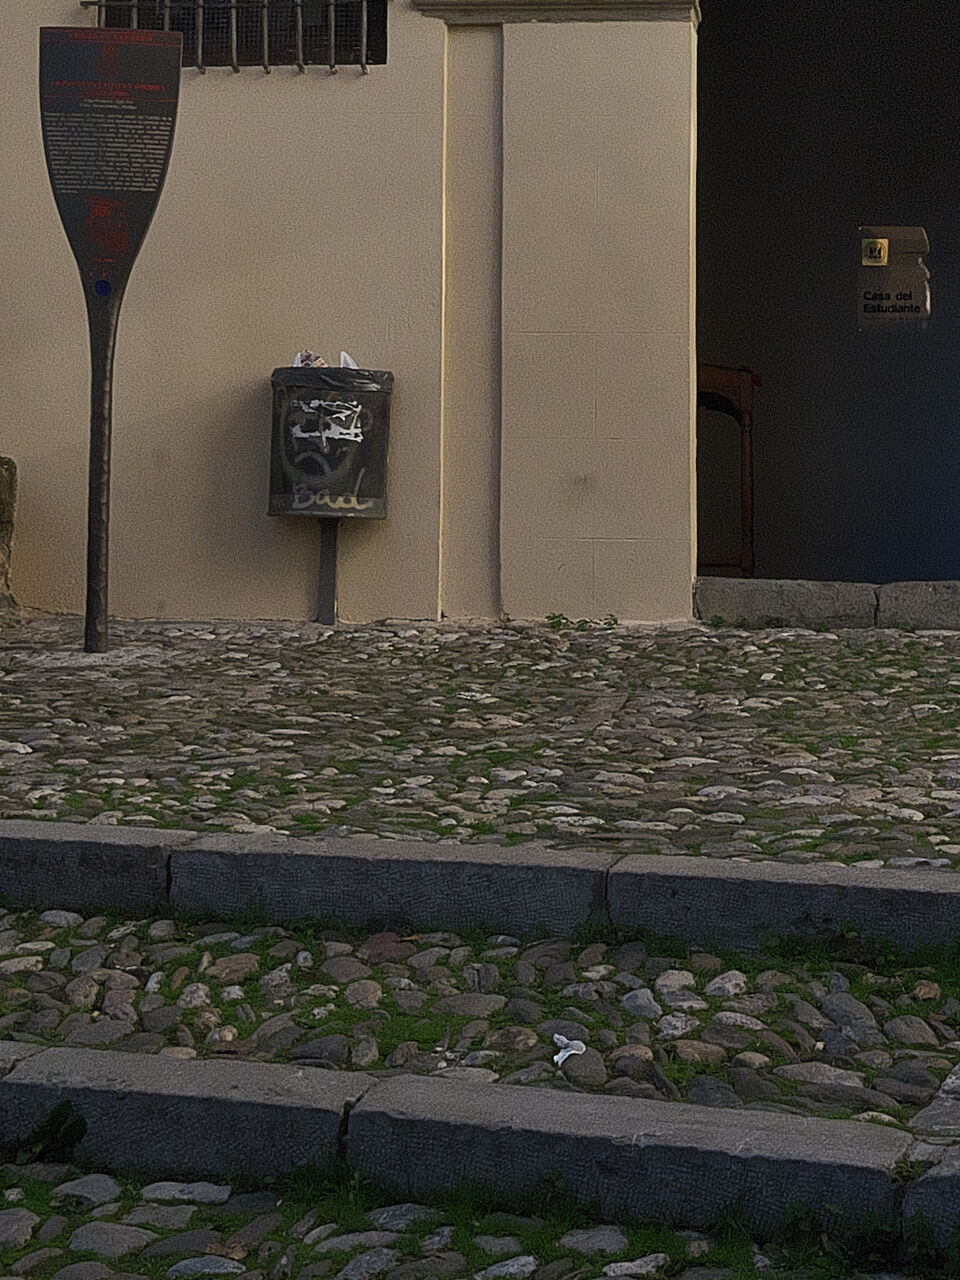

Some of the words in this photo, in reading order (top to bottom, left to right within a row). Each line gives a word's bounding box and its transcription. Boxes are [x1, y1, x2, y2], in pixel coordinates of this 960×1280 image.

[863, 291, 890, 301] Casa
[895, 291, 912, 301] del
[863, 303, 921, 313] Estudiante
